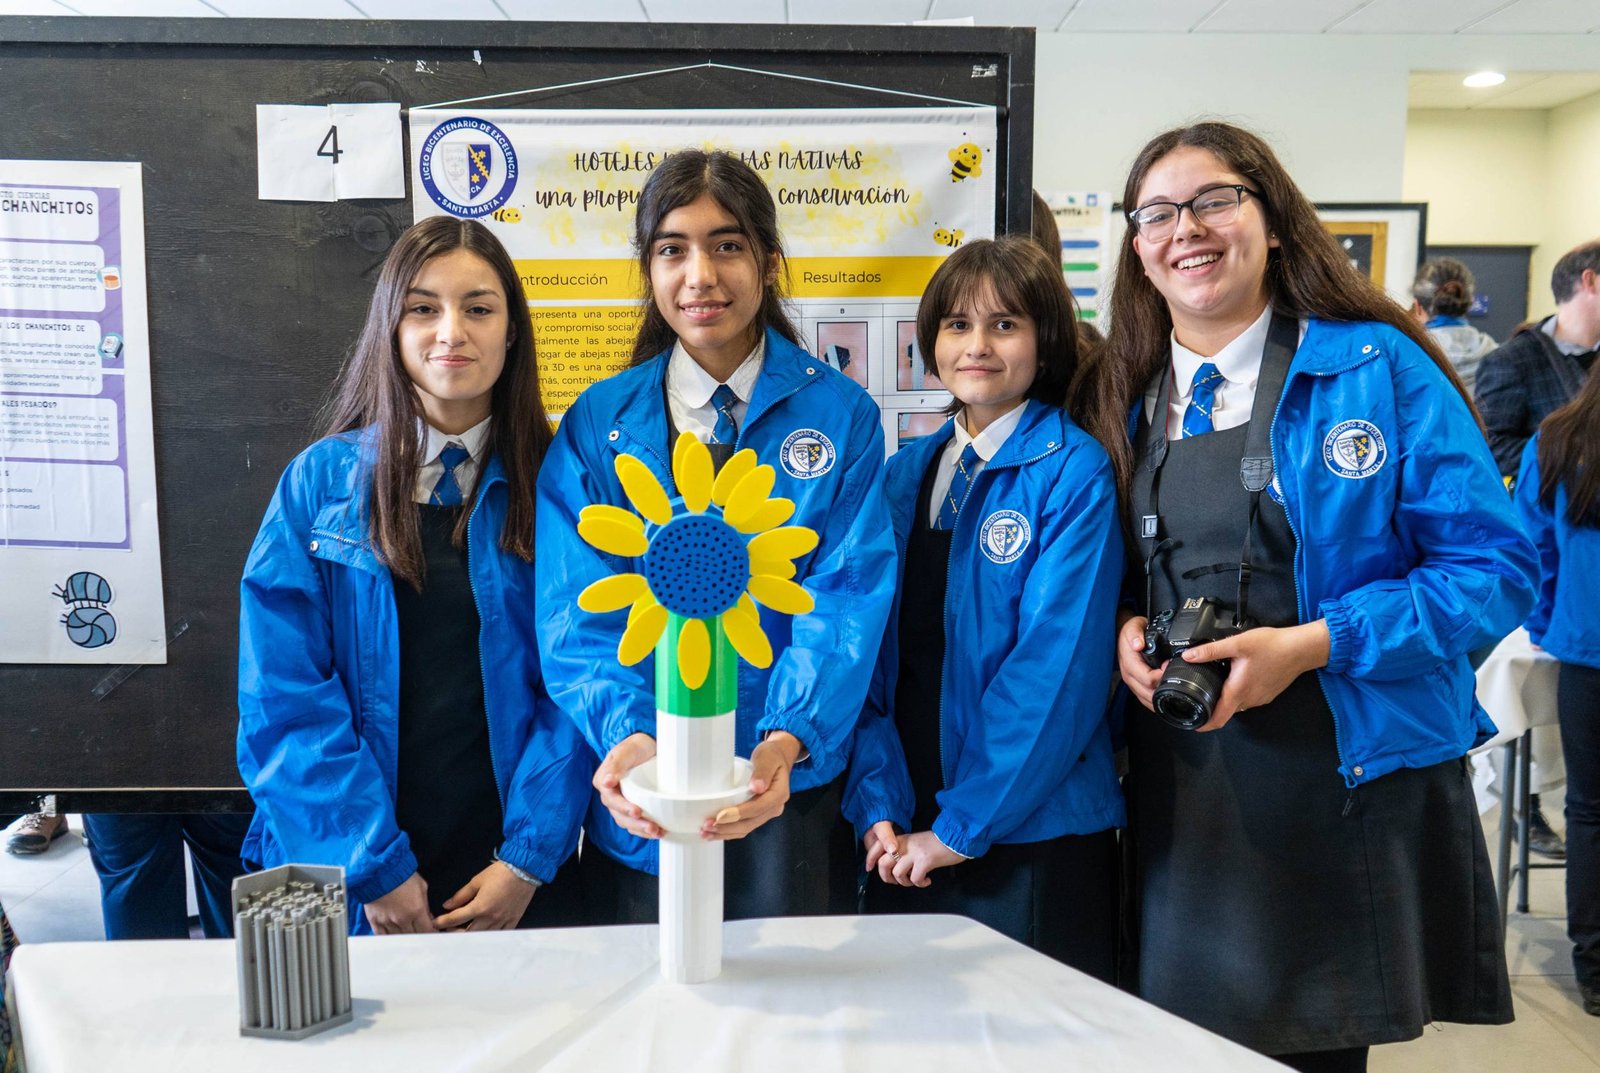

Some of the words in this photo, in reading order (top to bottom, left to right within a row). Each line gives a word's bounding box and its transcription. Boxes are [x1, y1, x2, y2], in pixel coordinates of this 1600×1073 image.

[317, 125, 344, 164] 4
[422, 155, 431, 180] LICEO
[428, 120, 478, 153] BICENTENARIO
[480, 123, 491, 132] DE
[490, 129, 516, 179] EXCELENCIA
[574, 151, 656, 172] HOTELES
[2, 200, 94, 215] CHANCHITOS
[442, 198, 468, 215] SANTA
[470, 198, 500, 215] MARTA
[536, 189, 577, 209] una
[583, 189, 641, 212] propu
[520, 273, 608, 286] ntroducción
[803, 271, 881, 283] Resultados
[531, 312, 576, 320] epresenta
[608, 310, 646, 320] oportun
[25, 323, 71, 331] CHANCHITOS
[545, 324, 604, 333] compromiso
[608, 323, 634, 332] social
[564, 350, 576, 358] de
[580, 350, 610, 360] abejas
[547, 389, 580, 398] especie
